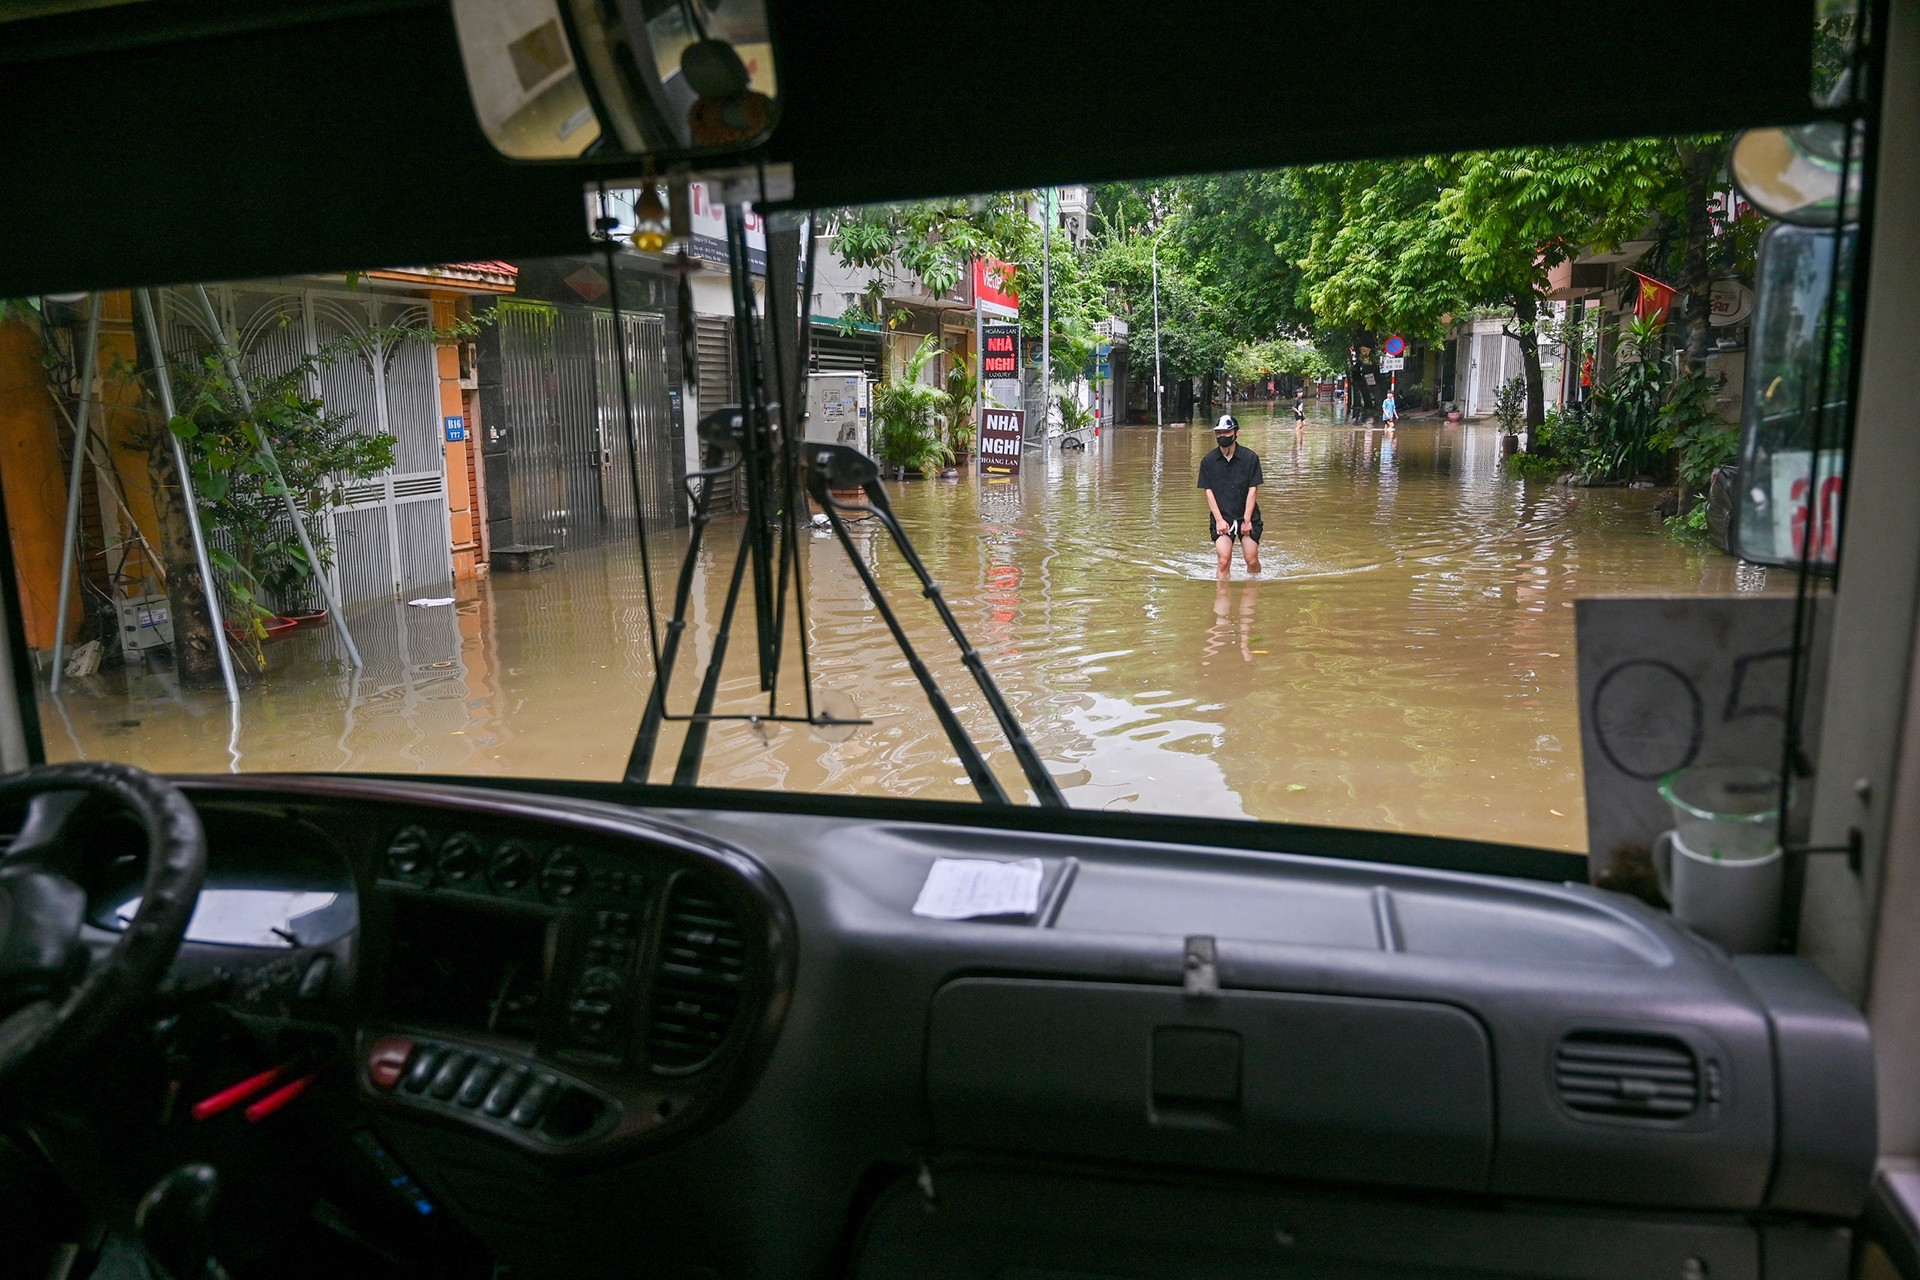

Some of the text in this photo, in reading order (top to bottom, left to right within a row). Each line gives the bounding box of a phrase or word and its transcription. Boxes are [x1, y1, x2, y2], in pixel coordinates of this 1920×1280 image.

[988, 335, 1013, 351] NHÀ
[986, 353, 1015, 370] NGHỈ
[447, 419, 461, 429] B16
[986, 413, 1020, 432] NHÀ
[981, 435, 1021, 456] NGHỈ
[980, 457, 1005, 465] HOÀNG
